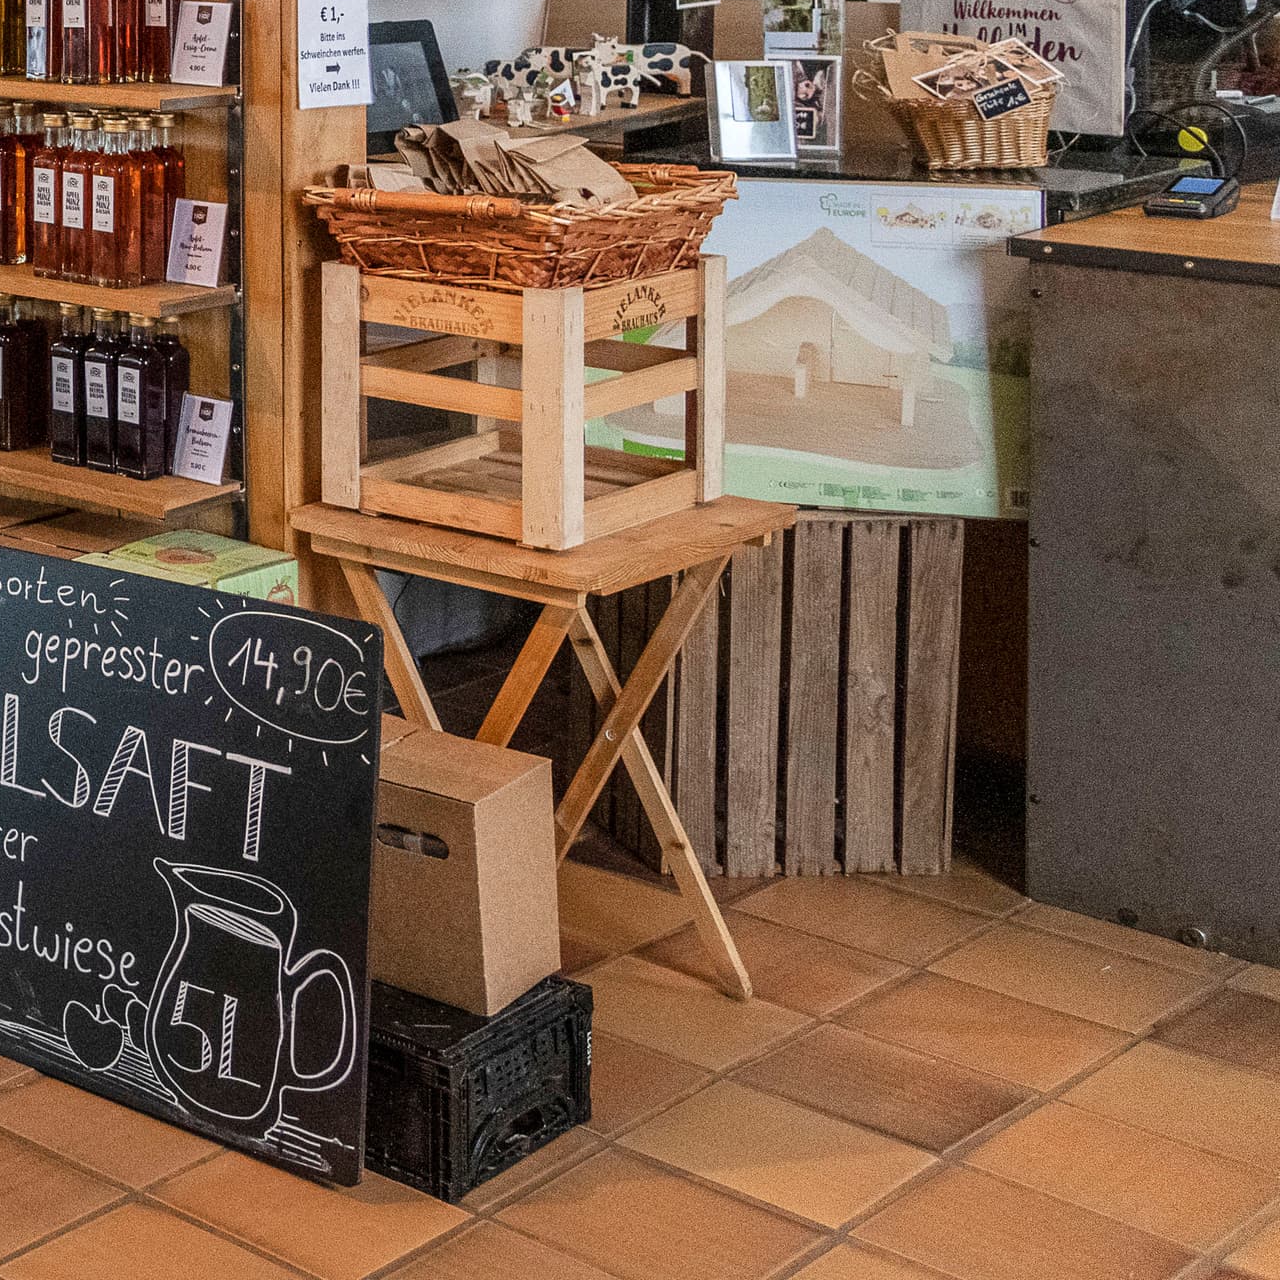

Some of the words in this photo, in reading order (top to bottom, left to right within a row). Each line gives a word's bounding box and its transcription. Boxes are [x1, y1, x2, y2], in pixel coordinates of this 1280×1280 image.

[320, 6, 328, 21] €
[330, 6, 345, 24] 1,-
[320, 32, 336, 42] Bitte
[337, 32, 346, 41] ins
[1008, 22, 1026, 37] IM
[300, 50, 341, 60] Schweinchen
[342, 47, 366, 57] werfen.
[309, 82, 331, 93] Vielen
[333, 81, 351, 91] Dank
[832, 208, 866, 218] EUROPE
[621, 311, 659, 332] BRAUHAUS
[22, 628, 206, 696] gepresster
[227, 637, 370, 715] 14,90€
[167, 980, 262, 1089] 5L
